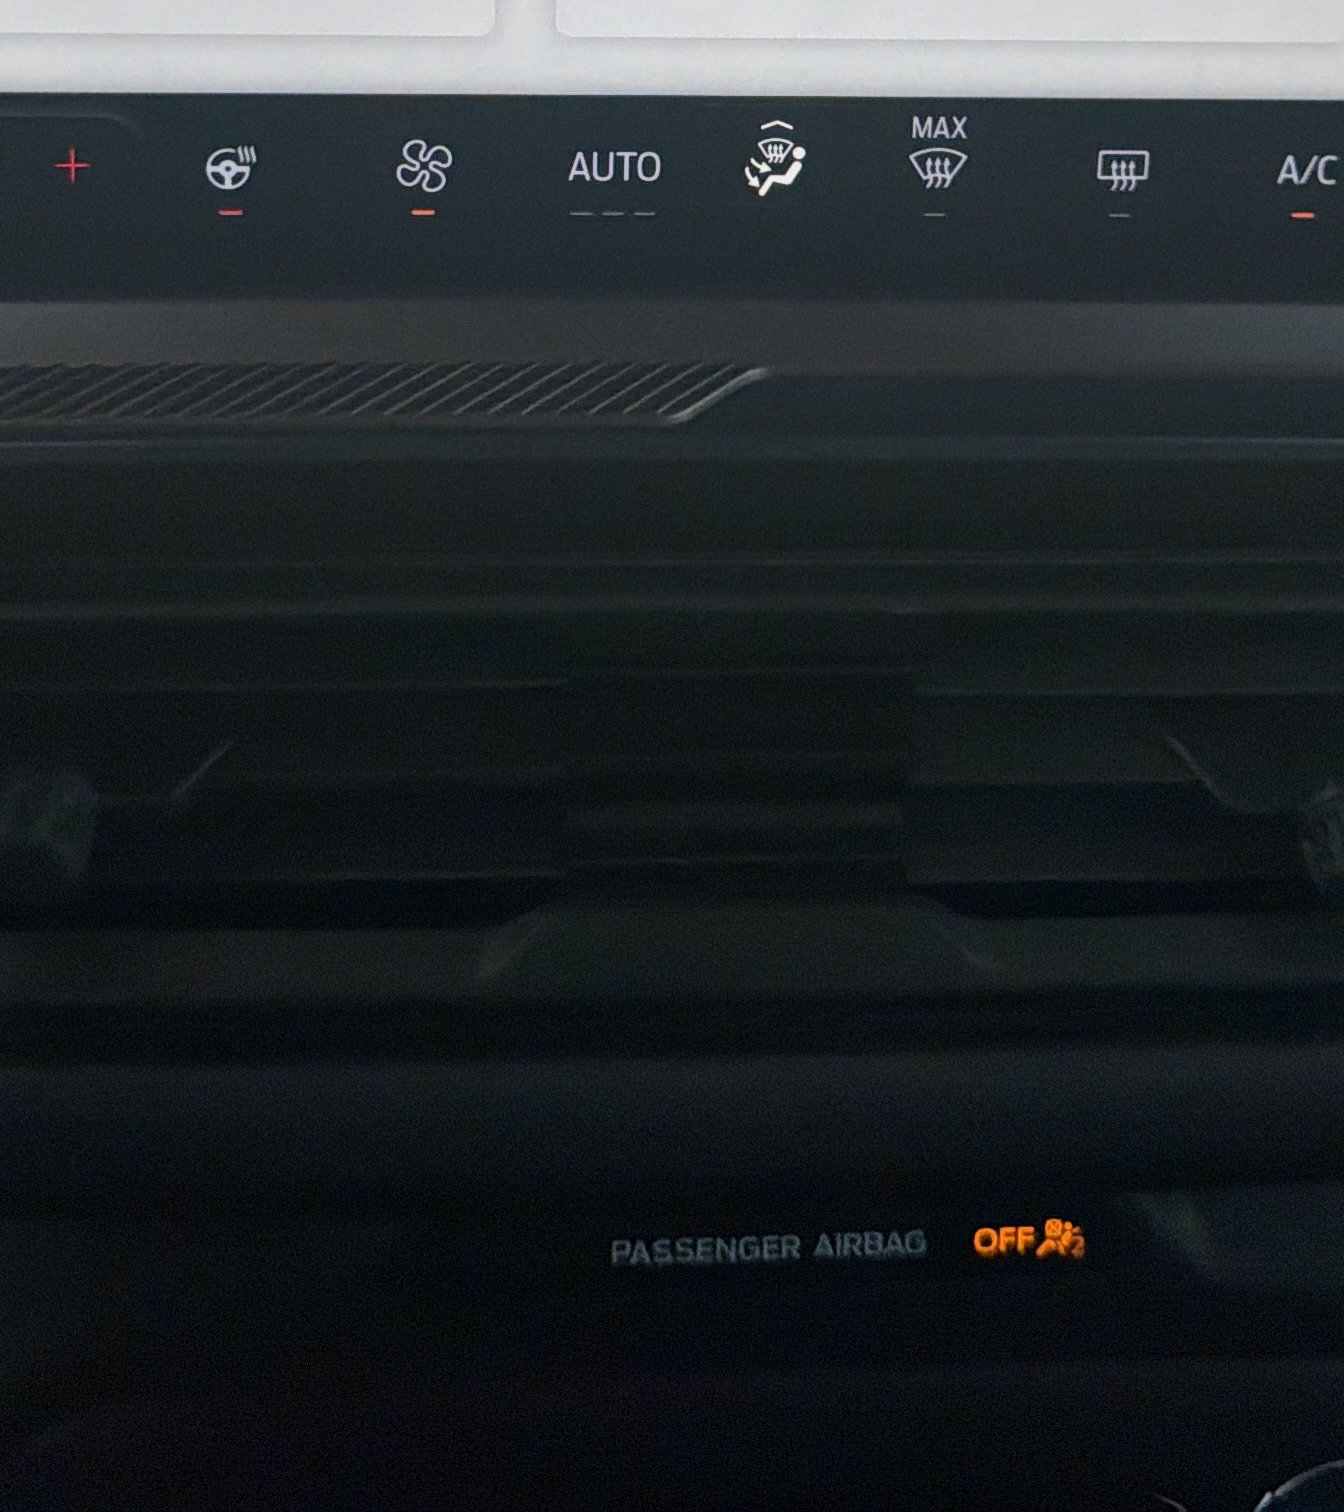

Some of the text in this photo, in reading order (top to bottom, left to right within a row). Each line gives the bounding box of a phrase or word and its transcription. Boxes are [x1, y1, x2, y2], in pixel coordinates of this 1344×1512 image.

[911, 114, 968, 140] MAX
[567, 150, 661, 184] AUTO
[1276, 154, 1338, 186] A/C
[610, 1228, 928, 1266] PASSENGER AIRBAG
[973, 1225, 1034, 1258] OFF
